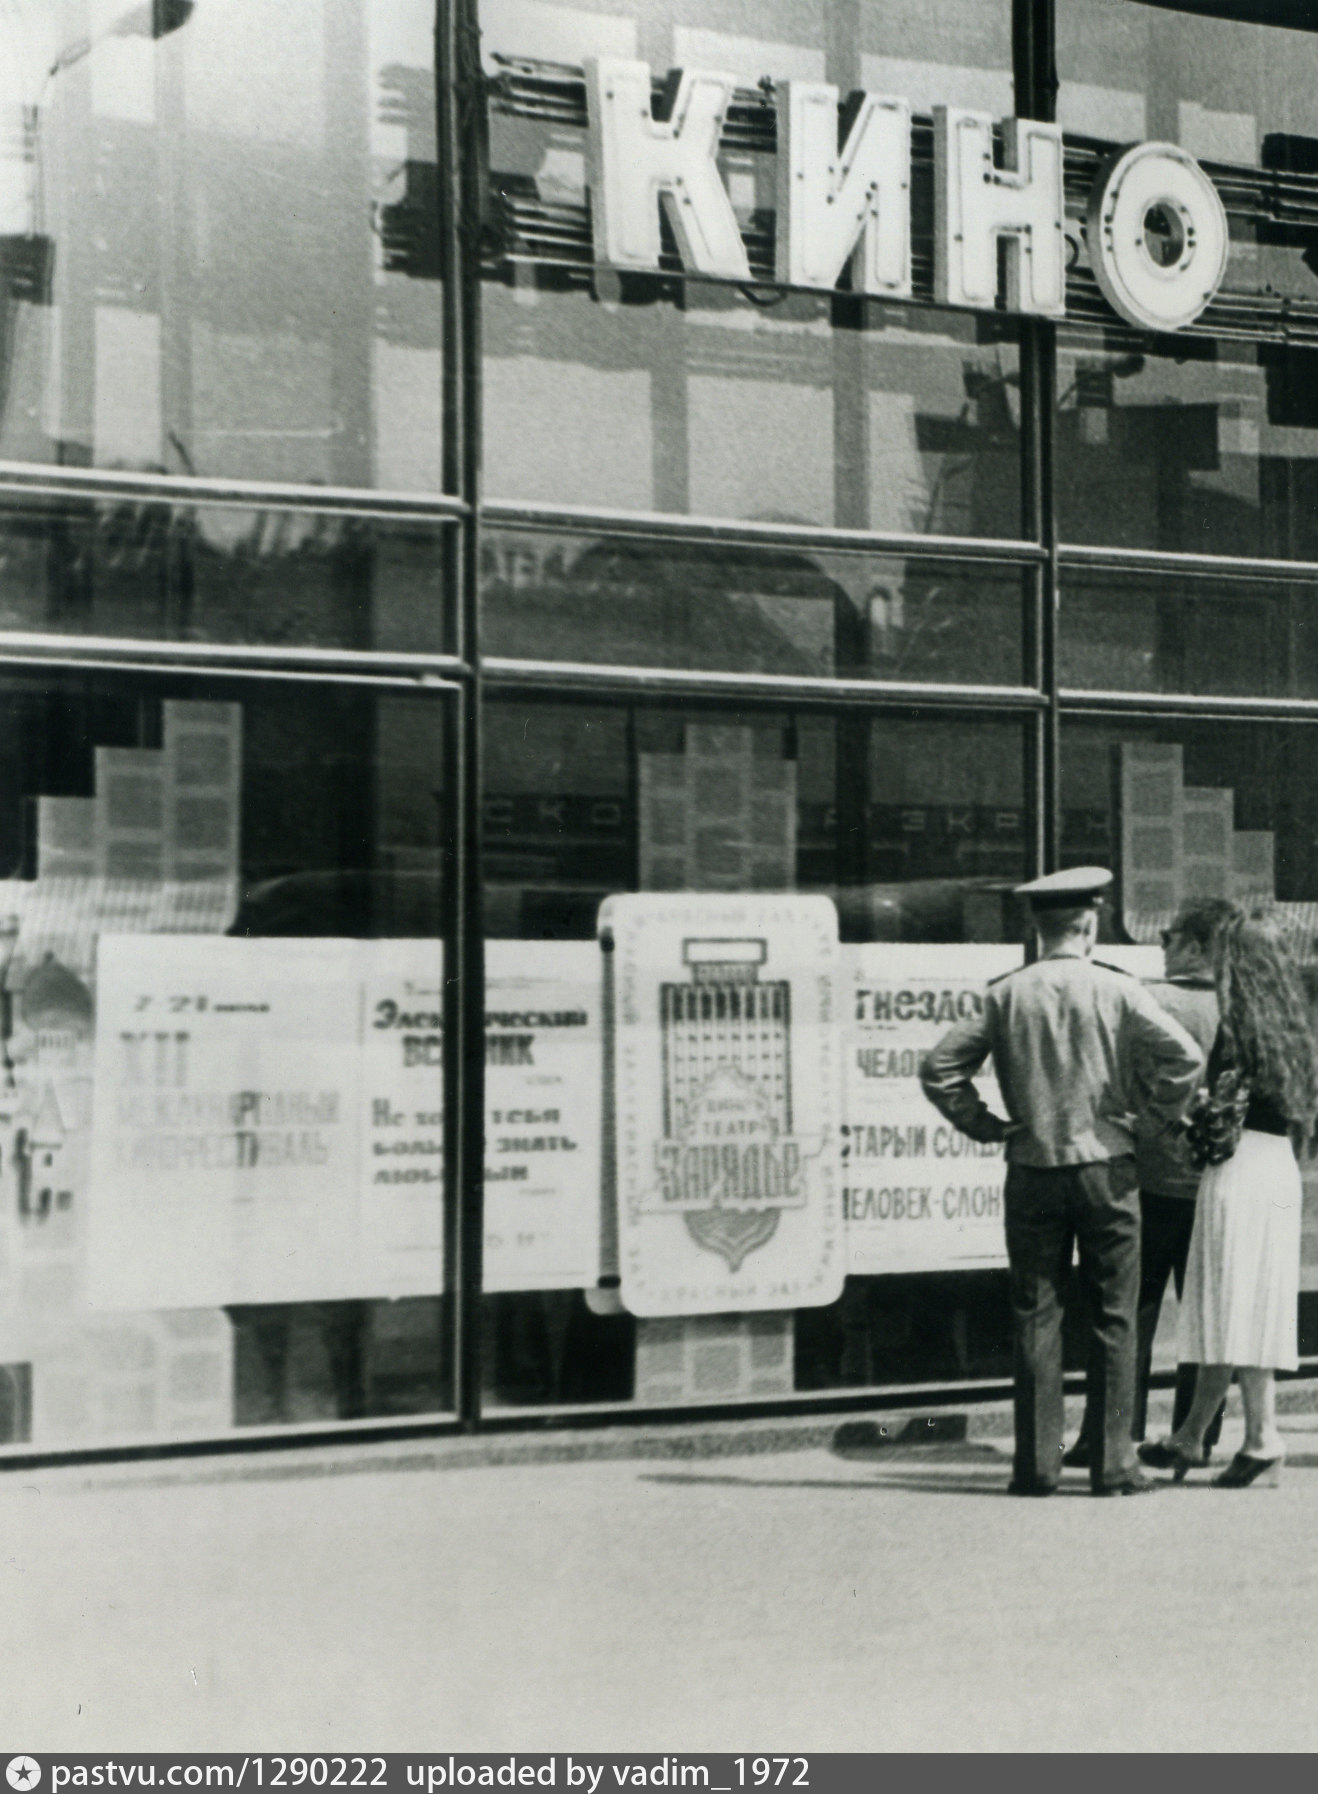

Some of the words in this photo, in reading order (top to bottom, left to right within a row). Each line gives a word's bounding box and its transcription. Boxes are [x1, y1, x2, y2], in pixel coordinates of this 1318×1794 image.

[581, 55, 1229, 332] КИНО
[372, 998, 589, 1030] Элекческий
[402, 1033, 535, 1067] ВСНИК
[856, 1048, 925, 1078] ЧЕЛО
[660, 1142, 800, 1202] ЗАРЯДЬЕ
